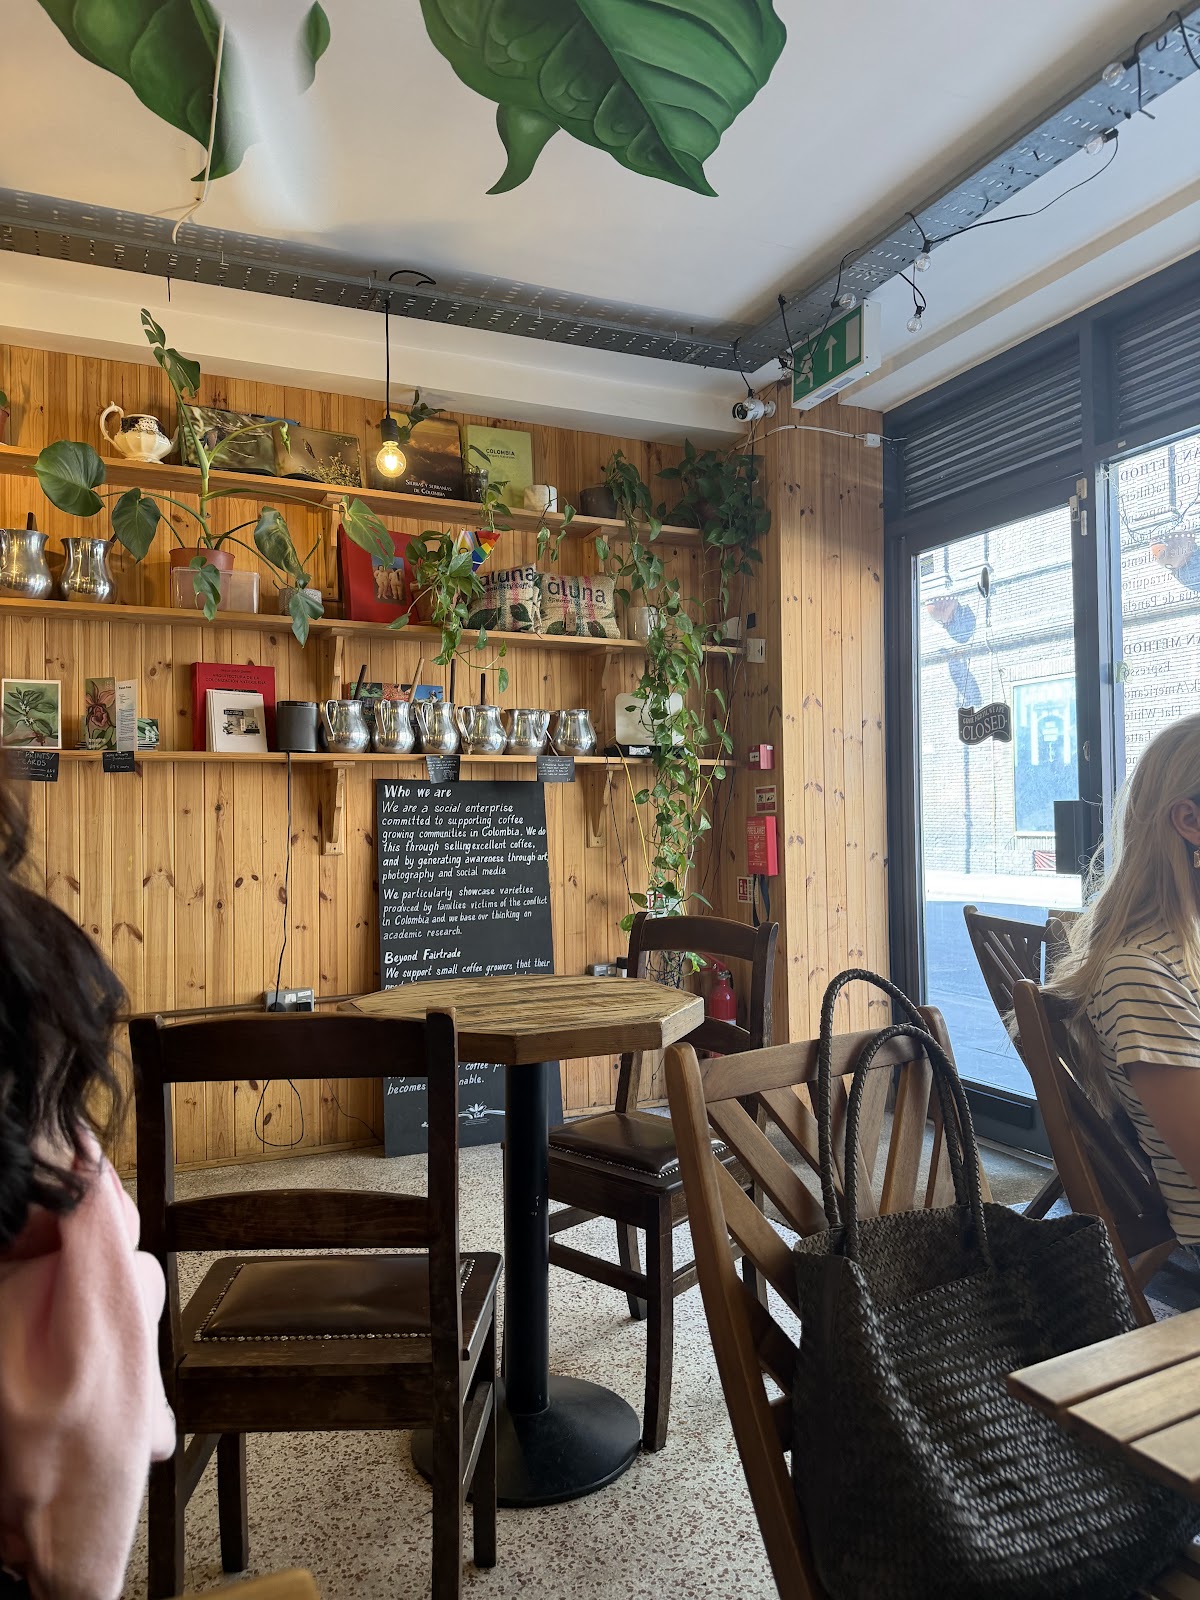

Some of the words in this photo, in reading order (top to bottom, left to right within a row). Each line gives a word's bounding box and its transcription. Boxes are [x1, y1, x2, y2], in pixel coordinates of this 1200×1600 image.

[480, 567, 535, 586] aluna
[962, 714, 1006, 740] CLOSED
[384, 785, 410, 798] Who
[418, 787, 430, 797] we
[434, 787, 452, 797] are
[382, 801, 398, 812] We
[402, 804, 417, 812] are
[435, 803, 460, 812] social
[465, 802, 513, 816] enterprise
[382, 816, 430, 826] committed
[435, 816, 443, 825] to
[448, 815, 491, 828] supporting
[498, 815, 523, 824] coffee
[383, 830, 414, 843] growing
[419, 829, 466, 837] communities
[482, 827, 523, 837] Colombia.
[526, 826, 536, 835] We
[383, 842, 400, 852] this
[406, 842, 439, 855] through
[472, 840, 506, 849] excellent
[383, 857, 398, 866] and
[405, 856, 414, 869] by
[418, 854, 461, 868] generating
[465, 855, 504, 863] awareness
[508, 853, 535, 865] through
[383, 869, 434, 883] photography
[438, 867, 452, 877] and
[456, 867, 478, 877] social
[482, 867, 506, 875] media
[383, 888, 399, 900] We
[402, 887, 452, 903] particularly
[459, 886, 495, 896] showcase
[500, 886, 534, 894] varieties
[383, 902, 419, 917] produced
[423, 902, 432, 914] by
[438, 900, 466, 911] families
[471, 900, 497, 909] victims
[500, 898, 506, 907] of
[510, 897, 520, 906] the
[523, 896, 547, 905] conflict
[382, 917, 390, 926] in
[395, 914, 429, 925] Colombia
[432, 913, 445, 923] and
[460, 913, 475, 921] base
[492, 910, 520, 921] thinking
[383, 930, 422, 940] academic
[427, 926, 462, 937] research.
[384, 950, 418, 965] Beyond
[423, 947, 461, 961] Fairtrade
[386, 967, 398, 979] We
[402, 965, 432, 981] support
[436, 964, 457, 975] small
[462, 962, 482, 972] coffee
[486, 962, 512, 976] growers
[516, 959, 531, 968] that
[534, 958, 550, 967] their
[388, 1083, 426, 1095] becomes
